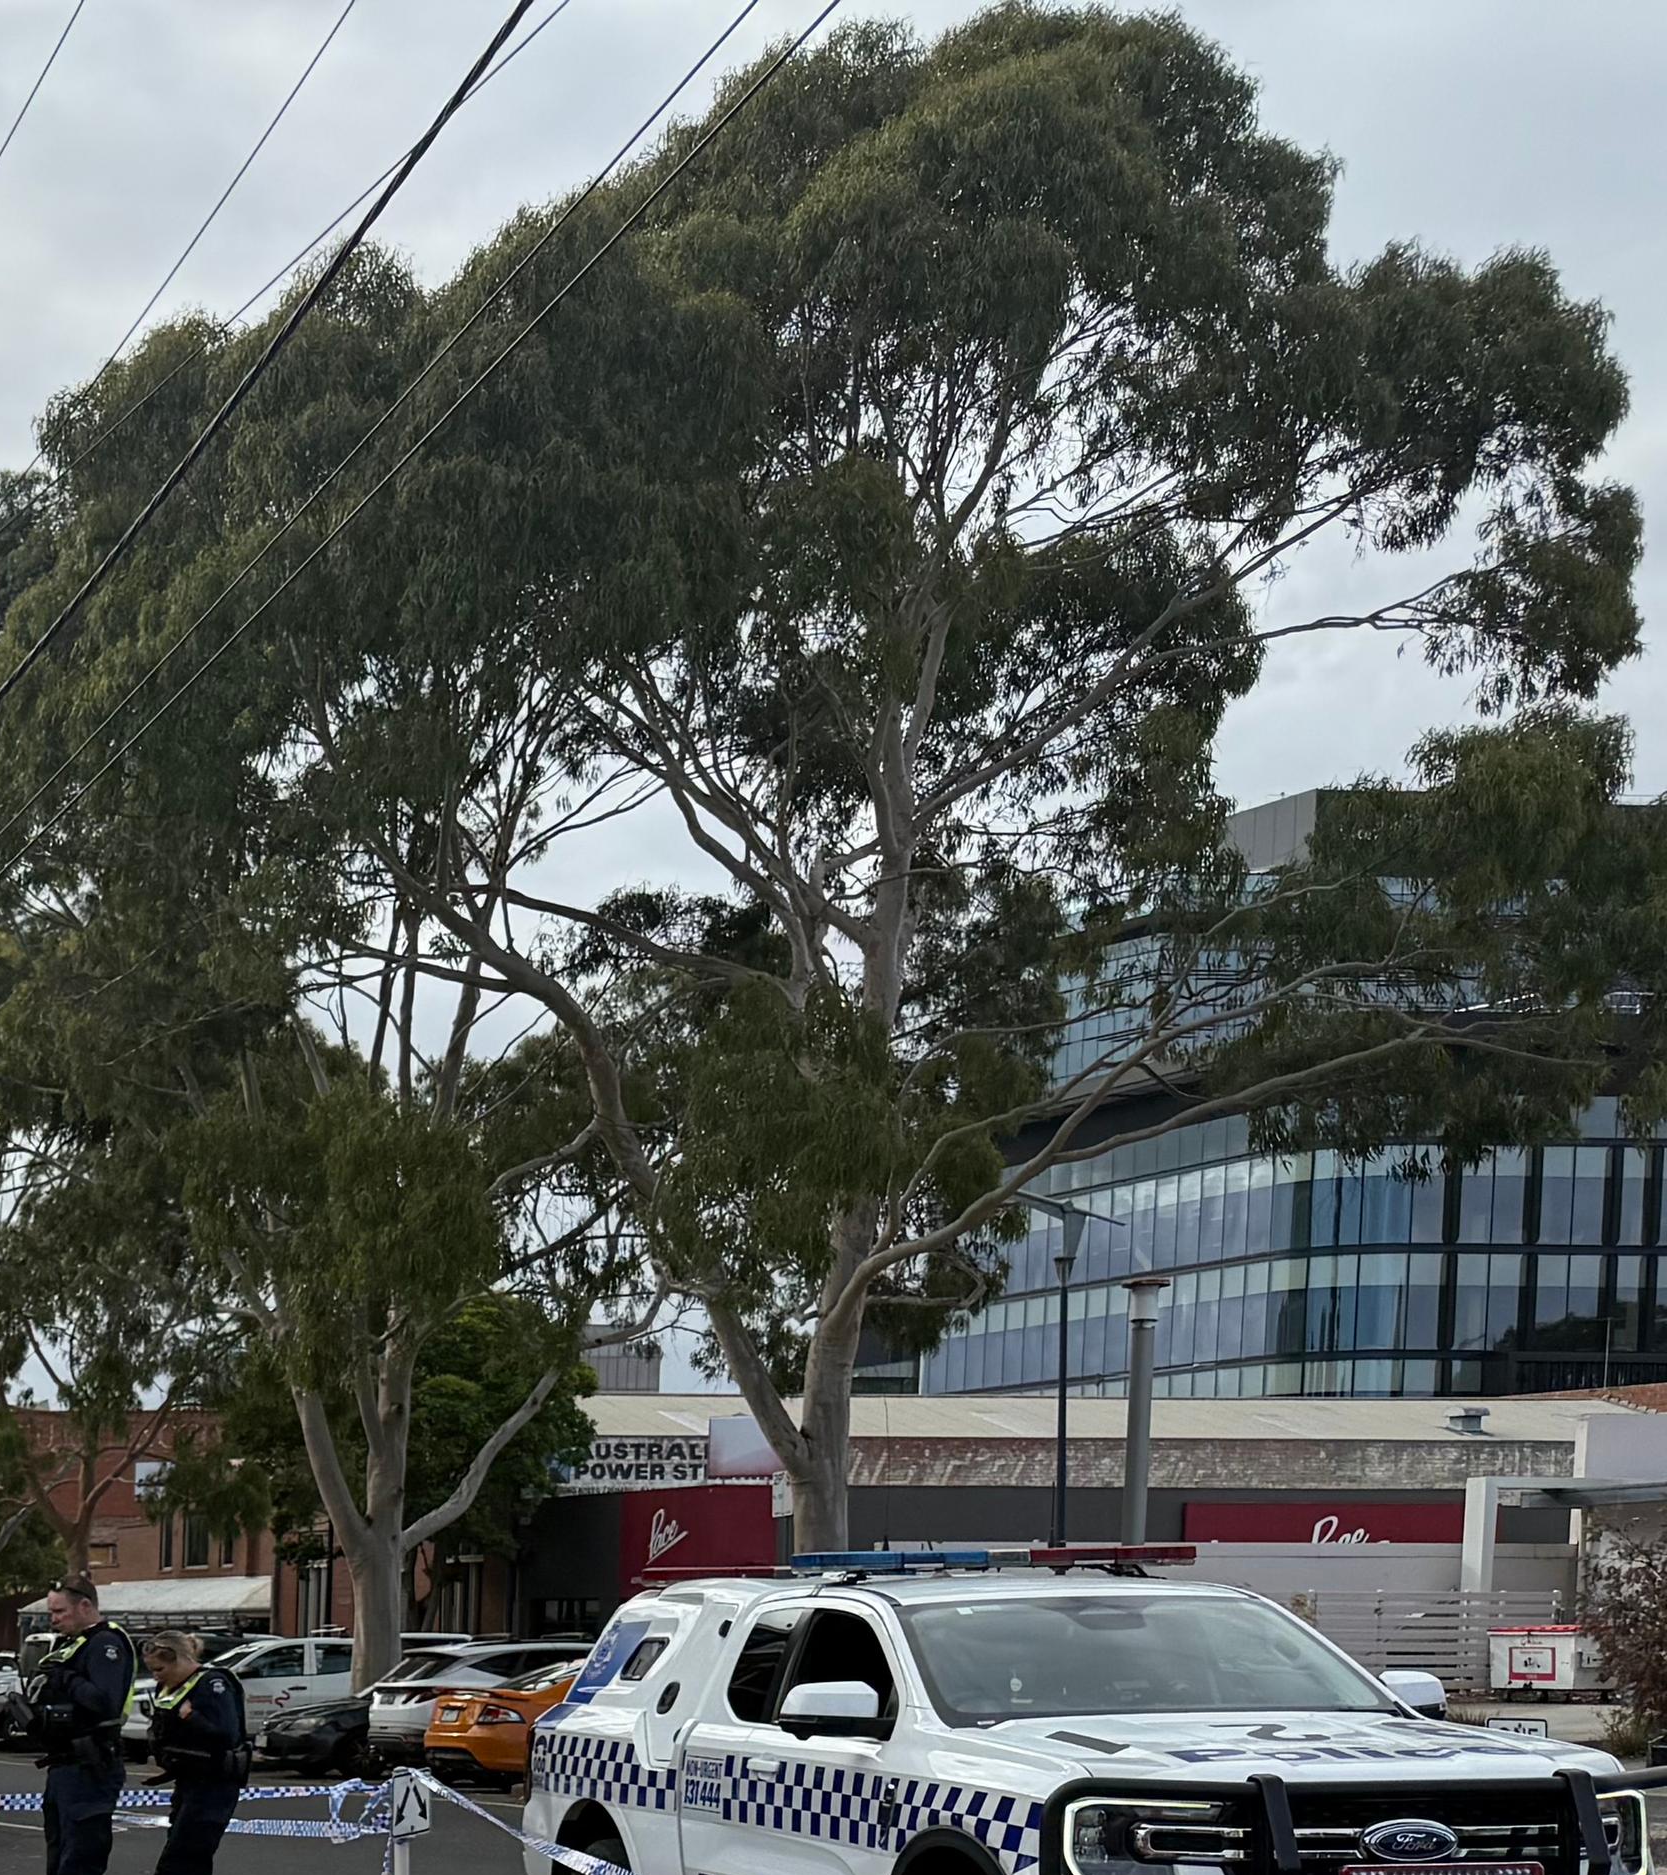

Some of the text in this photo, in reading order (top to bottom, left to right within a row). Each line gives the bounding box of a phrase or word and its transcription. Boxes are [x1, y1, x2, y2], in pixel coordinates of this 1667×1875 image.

[574, 1463, 708, 1481] POWER ST
[1165, 1746, 1530, 1763] Police
[700, 1781, 721, 1809] 444
[1392, 1832, 1437, 1851] Ford
